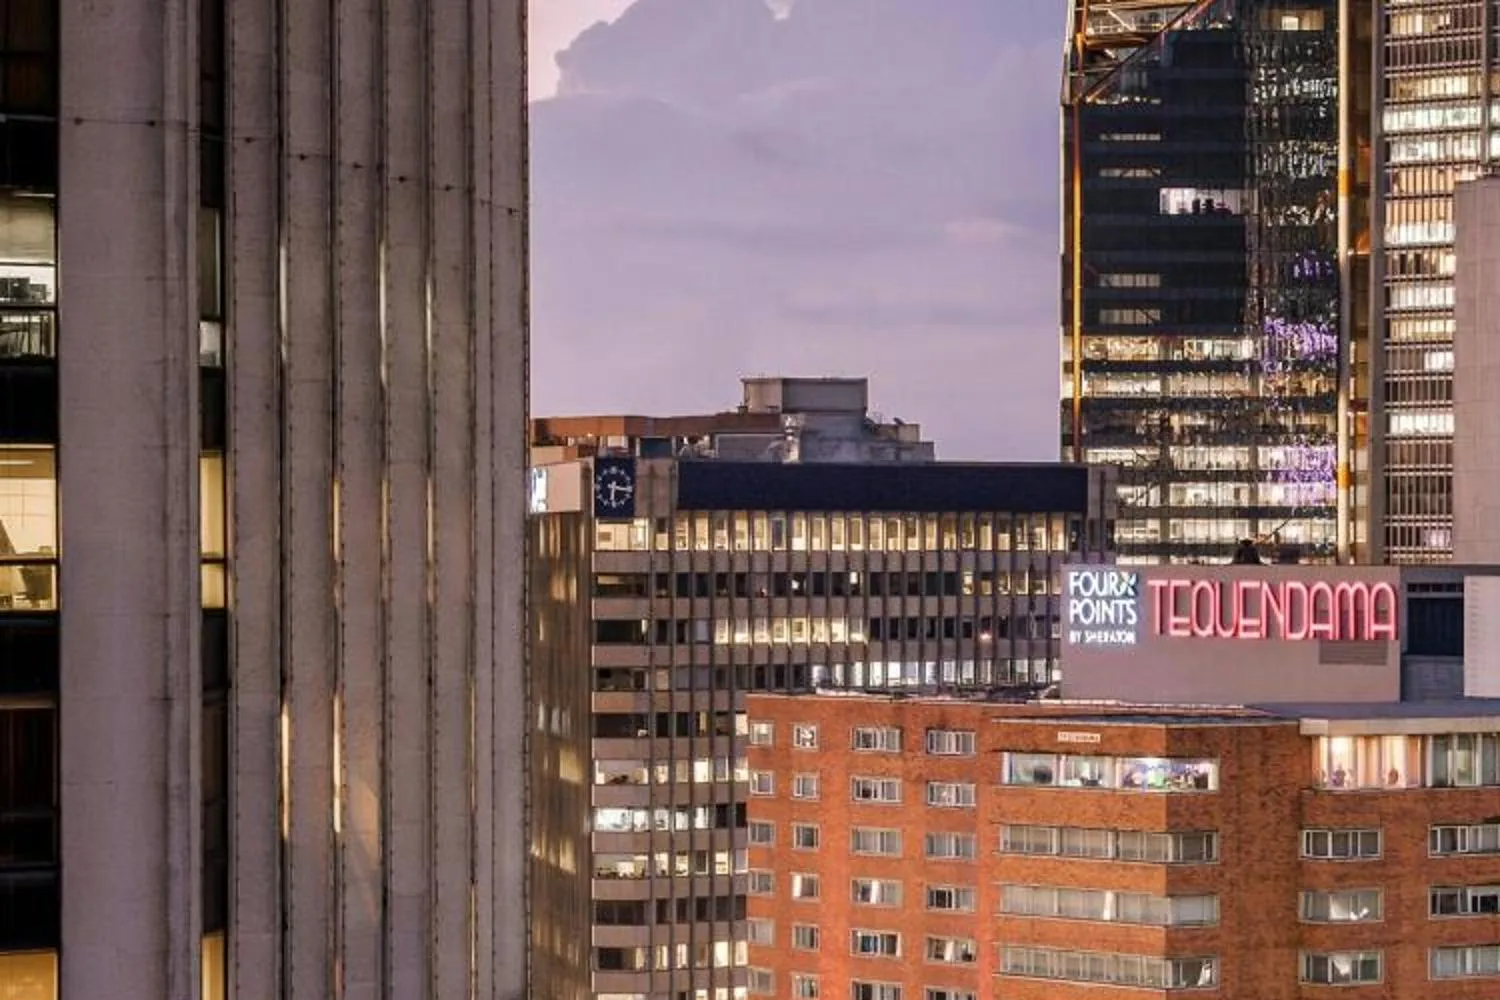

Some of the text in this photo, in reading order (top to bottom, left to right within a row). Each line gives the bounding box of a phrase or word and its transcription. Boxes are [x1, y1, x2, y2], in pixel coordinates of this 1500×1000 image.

[1069, 571, 1121, 597] FOUR
[1069, 599, 1137, 625] POINTS
[1147, 579, 1397, 641] TEQUENDAMA
